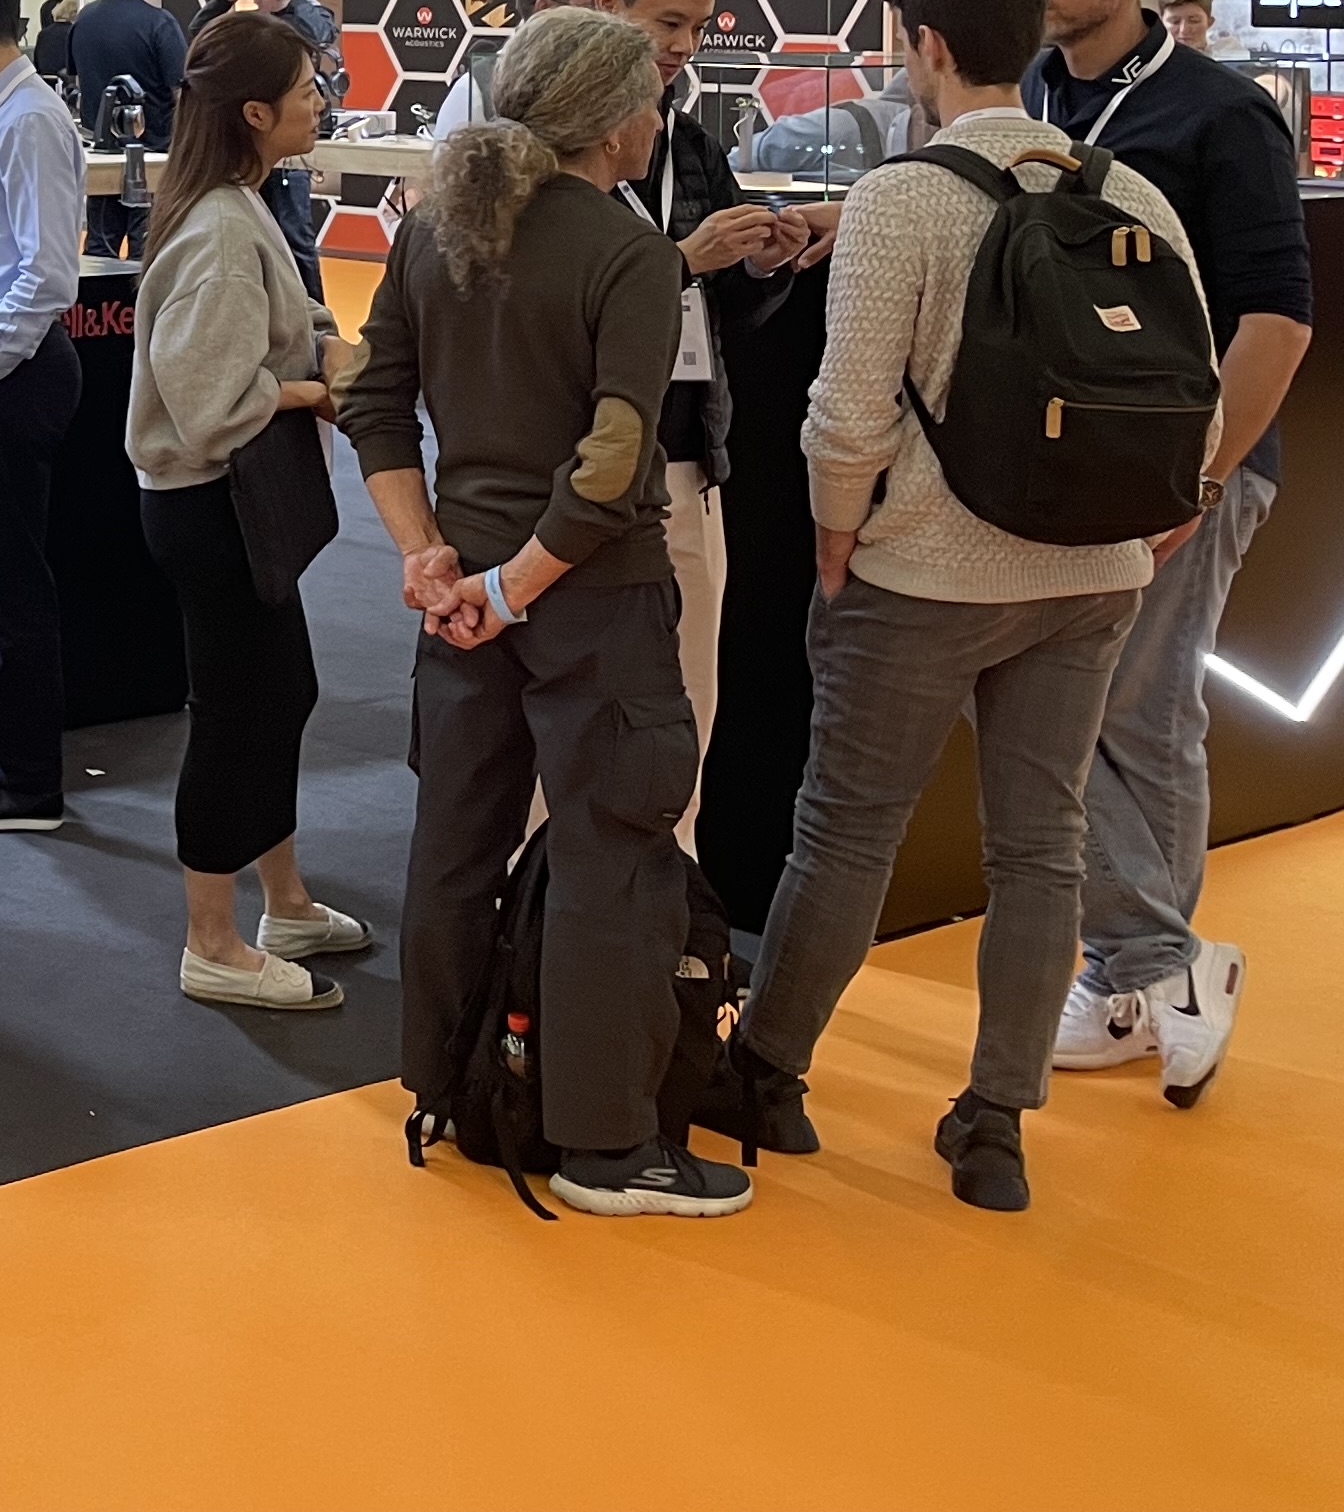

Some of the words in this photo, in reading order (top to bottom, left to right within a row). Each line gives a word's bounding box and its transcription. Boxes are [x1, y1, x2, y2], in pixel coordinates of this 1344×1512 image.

[392, 26, 457, 39] WARWICK
[405, 39, 445, 48] ACOUSTICS
[702, 33, 766, 48] ARWICK
